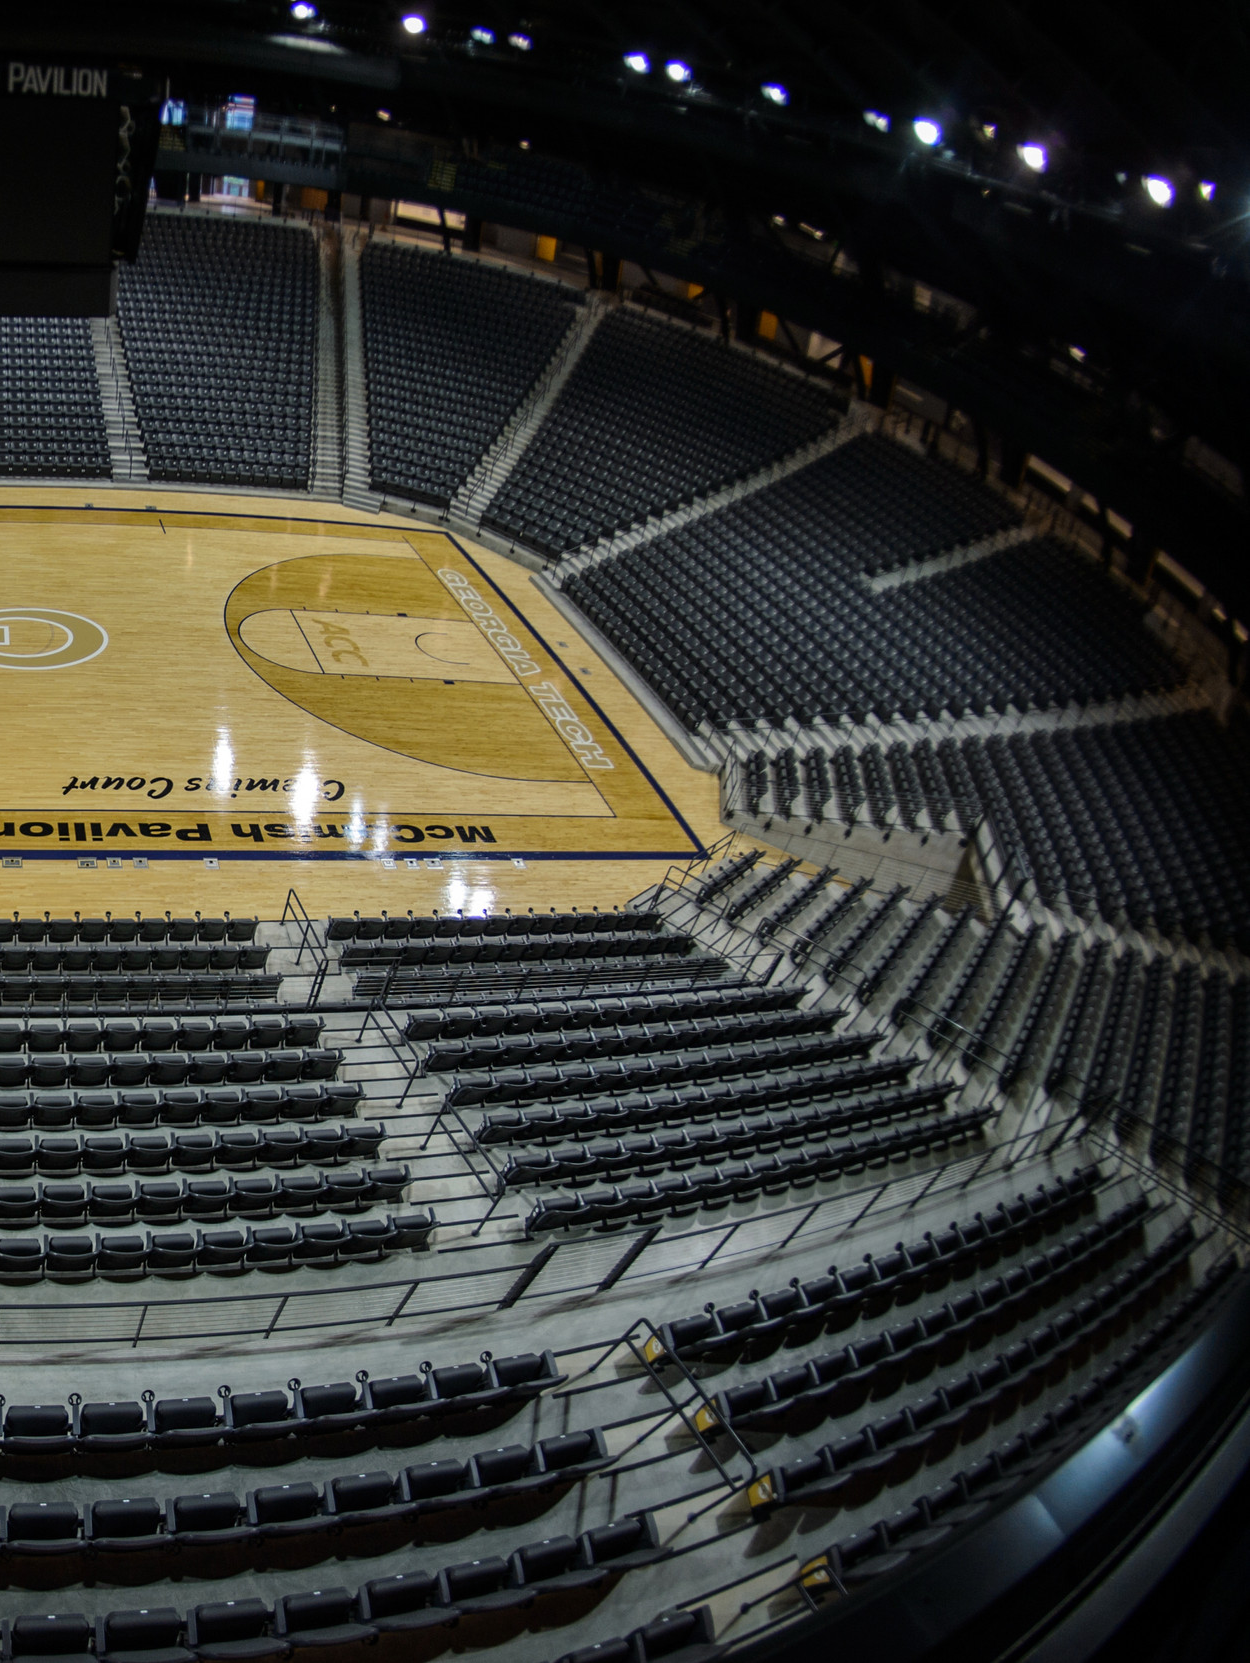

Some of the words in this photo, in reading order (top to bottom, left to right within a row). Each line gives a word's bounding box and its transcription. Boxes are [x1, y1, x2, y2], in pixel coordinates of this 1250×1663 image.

[8, 62, 108, 98] PAVILION
[311, 618, 369, 667] ACC
[437, 567, 541, 677] GEORGIA
[529, 681, 615, 770] TECH
[62, 775, 174, 800] Court
